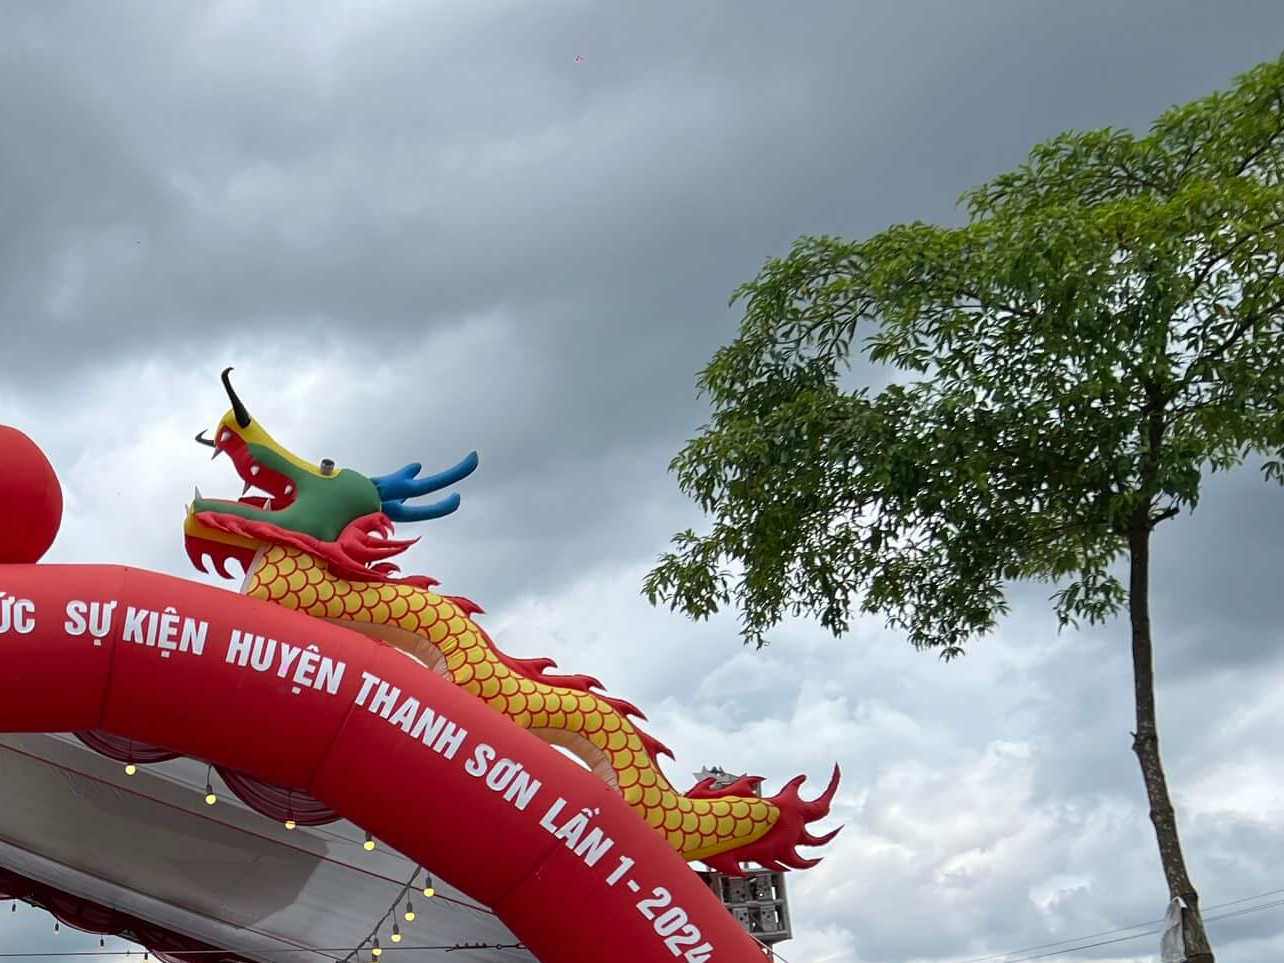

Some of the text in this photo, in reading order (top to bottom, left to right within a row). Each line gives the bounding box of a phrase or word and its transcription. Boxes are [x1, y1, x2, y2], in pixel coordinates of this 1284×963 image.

[65, 600, 118, 646] SỰ
[122, 606, 209, 658] KIỆN
[225, 629, 346, 695] HUYỆN
[354, 671, 468, 760] THANH
[465, 743, 542, 811] SƠN
[539, 797, 615, 867] LẦN
[605, 855, 635, 886] 1
